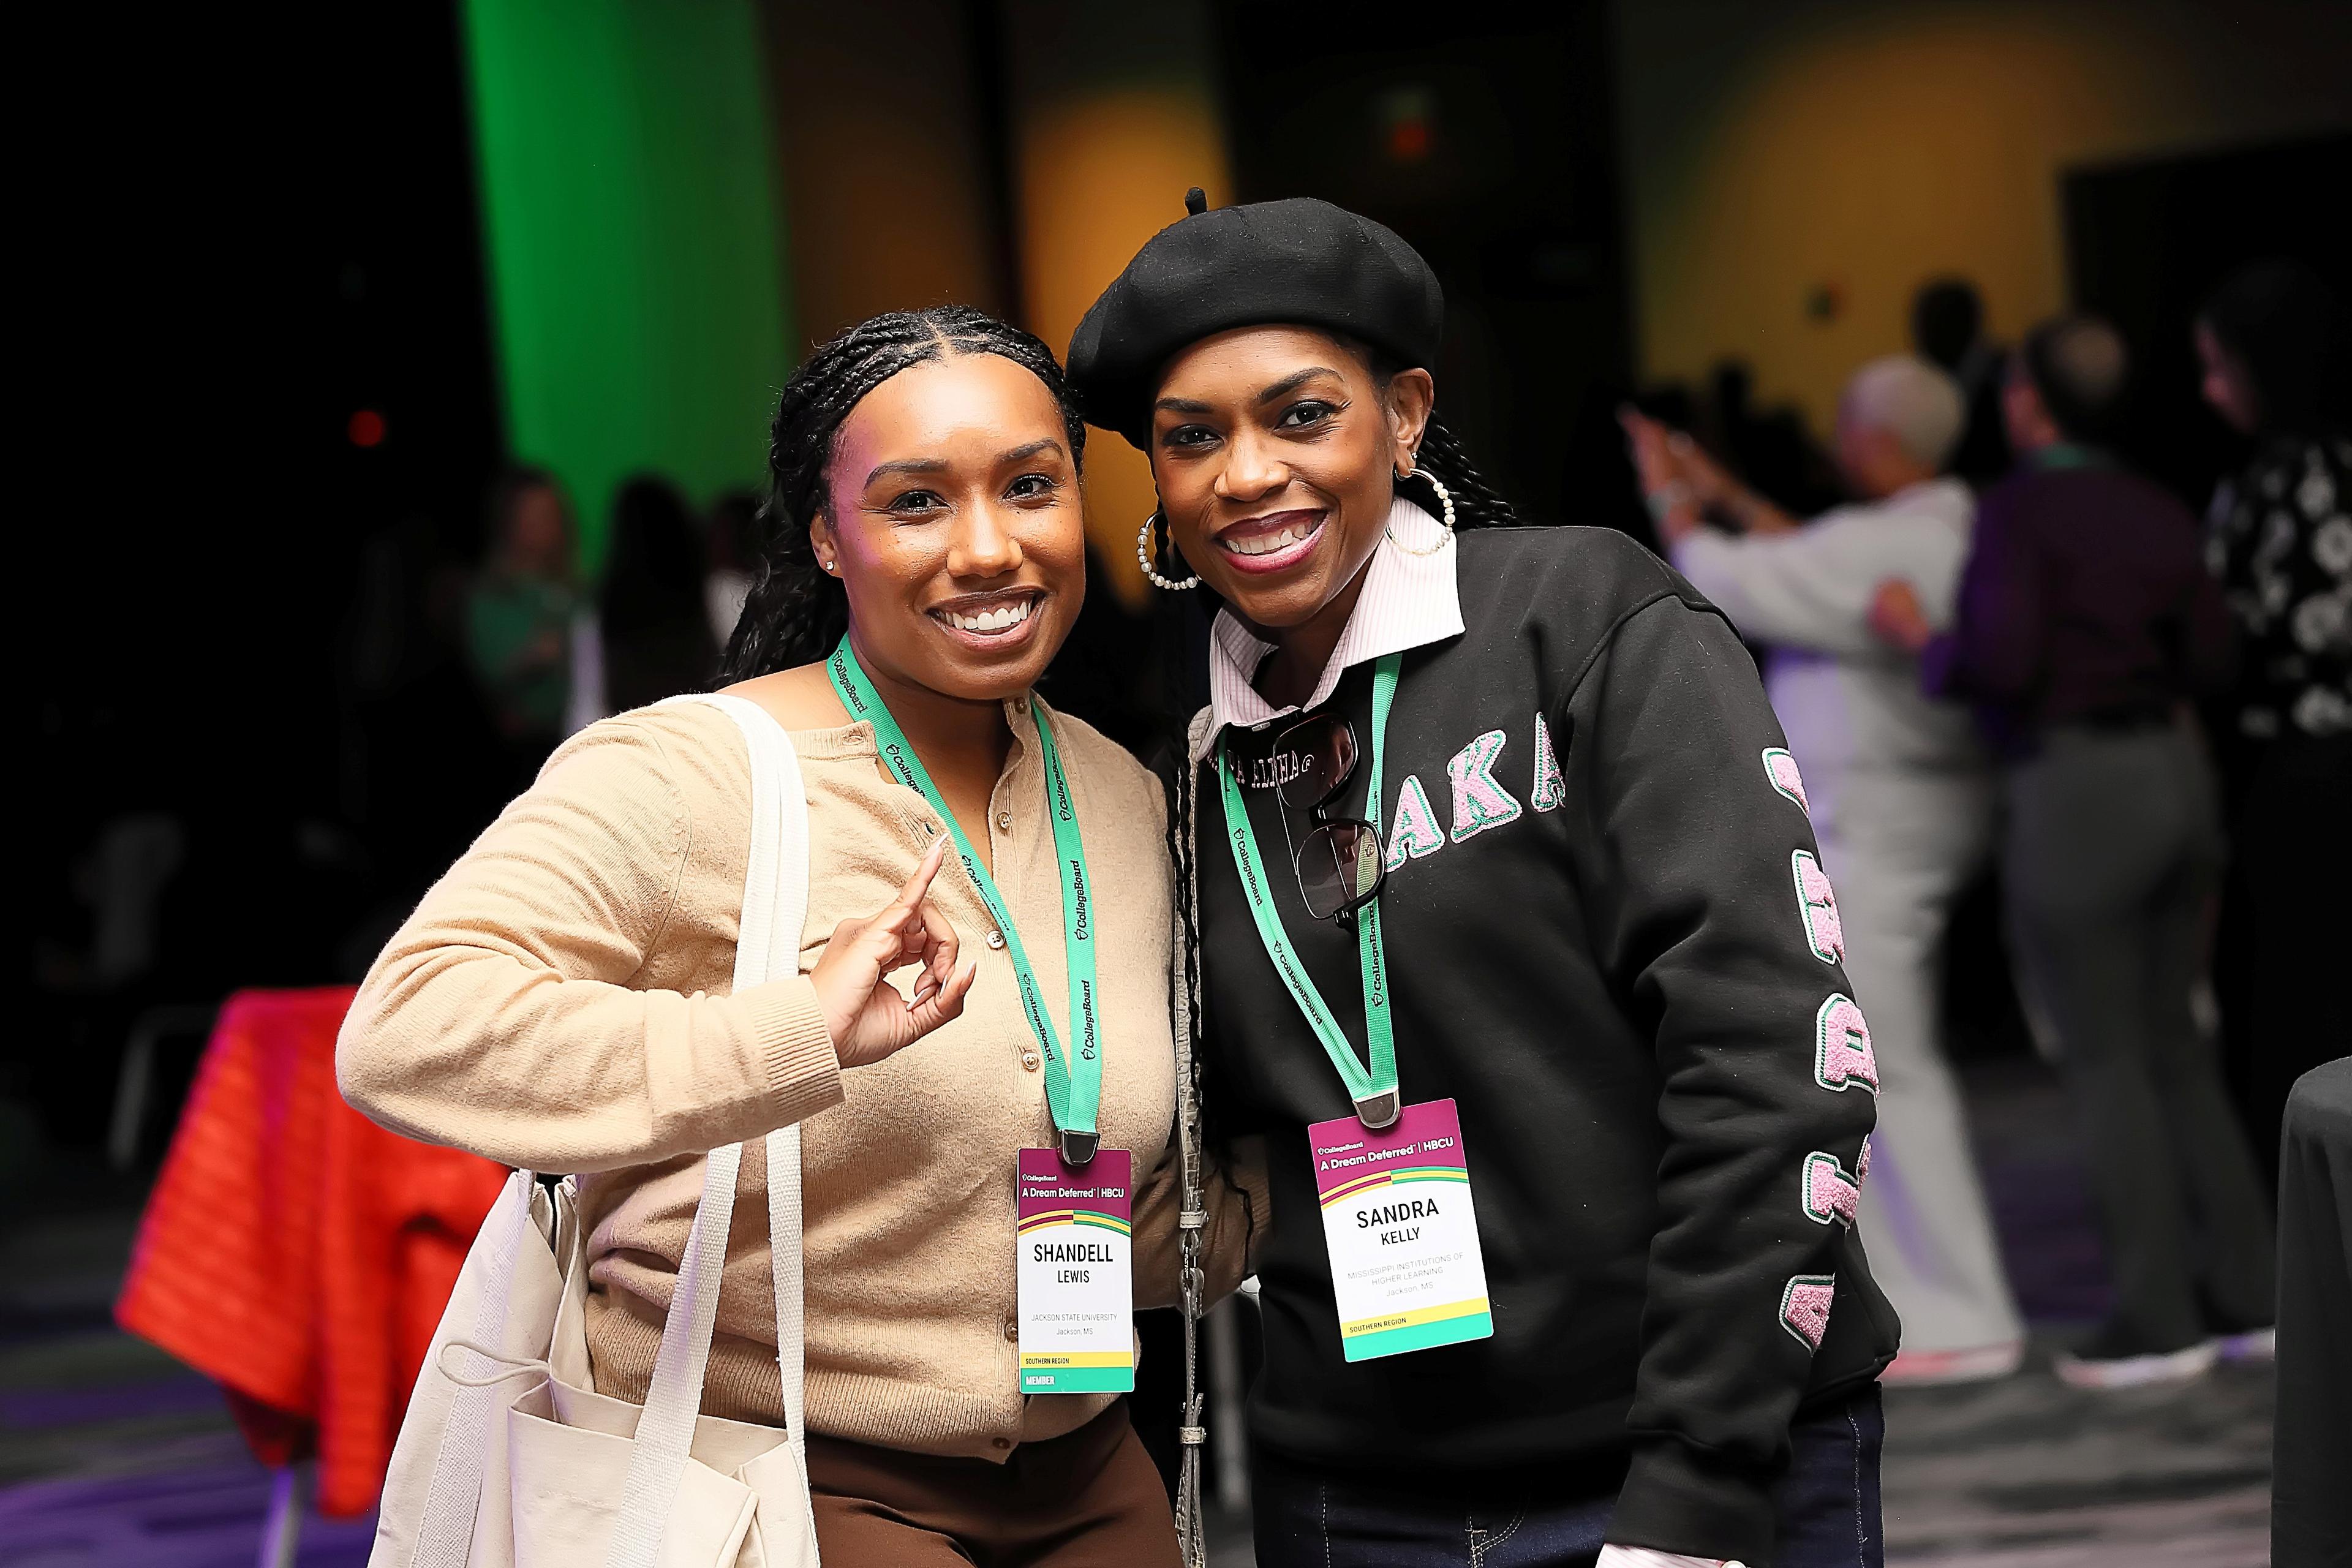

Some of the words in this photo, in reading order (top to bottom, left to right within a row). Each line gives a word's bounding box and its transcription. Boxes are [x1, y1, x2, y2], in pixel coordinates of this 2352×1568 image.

[834, 658, 868, 714] CollegeBoard
[894, 756, 925, 797] College
[1238, 841, 1263, 907] CollegeBoard
[1071, 860, 1087, 929] CollegeBoard
[1367, 905, 1382, 991] CollegeBoard
[1280, 953, 1323, 1026] CollegeBoard
[1026, 987, 1055, 1062] CollegeBoard
[1082, 980, 1095, 1049] CollegeBoard
[1320, 1161, 1330, 1171] A
[1330, 1155, 1366, 1169] Dream
[1423, 1136, 1454, 1152] HBCU
[1324, 1141, 1363, 1154] CollegeBoard
[1022, 1188, 1029, 1197] A
[1030, 1188, 1057, 1197] Dream
[1101, 1188, 1125, 1198] HBCU
[1357, 1198, 1439, 1229] SANDRA
[1381, 1227, 1420, 1246] KELLY
[1034, 1244, 1114, 1262] SHANDELL
[1348, 1265, 1395, 1280] MISSISSIPPI
[1396, 1254, 1452, 1270] INSTITUTIONS
[1058, 1270, 1090, 1283] LEWIS
[1371, 1274, 1402, 1286] HIGHER
[1403, 1266, 1444, 1280] LEARNING
[1386, 1284, 1419, 1297] Jackson,
[1421, 1281, 1434, 1290] MS
[1349, 1322, 1382, 1333] SOUTHERN
[1384, 1317, 1406, 1327] REGION
[1025, 1376, 1055, 1385] MEMBER
